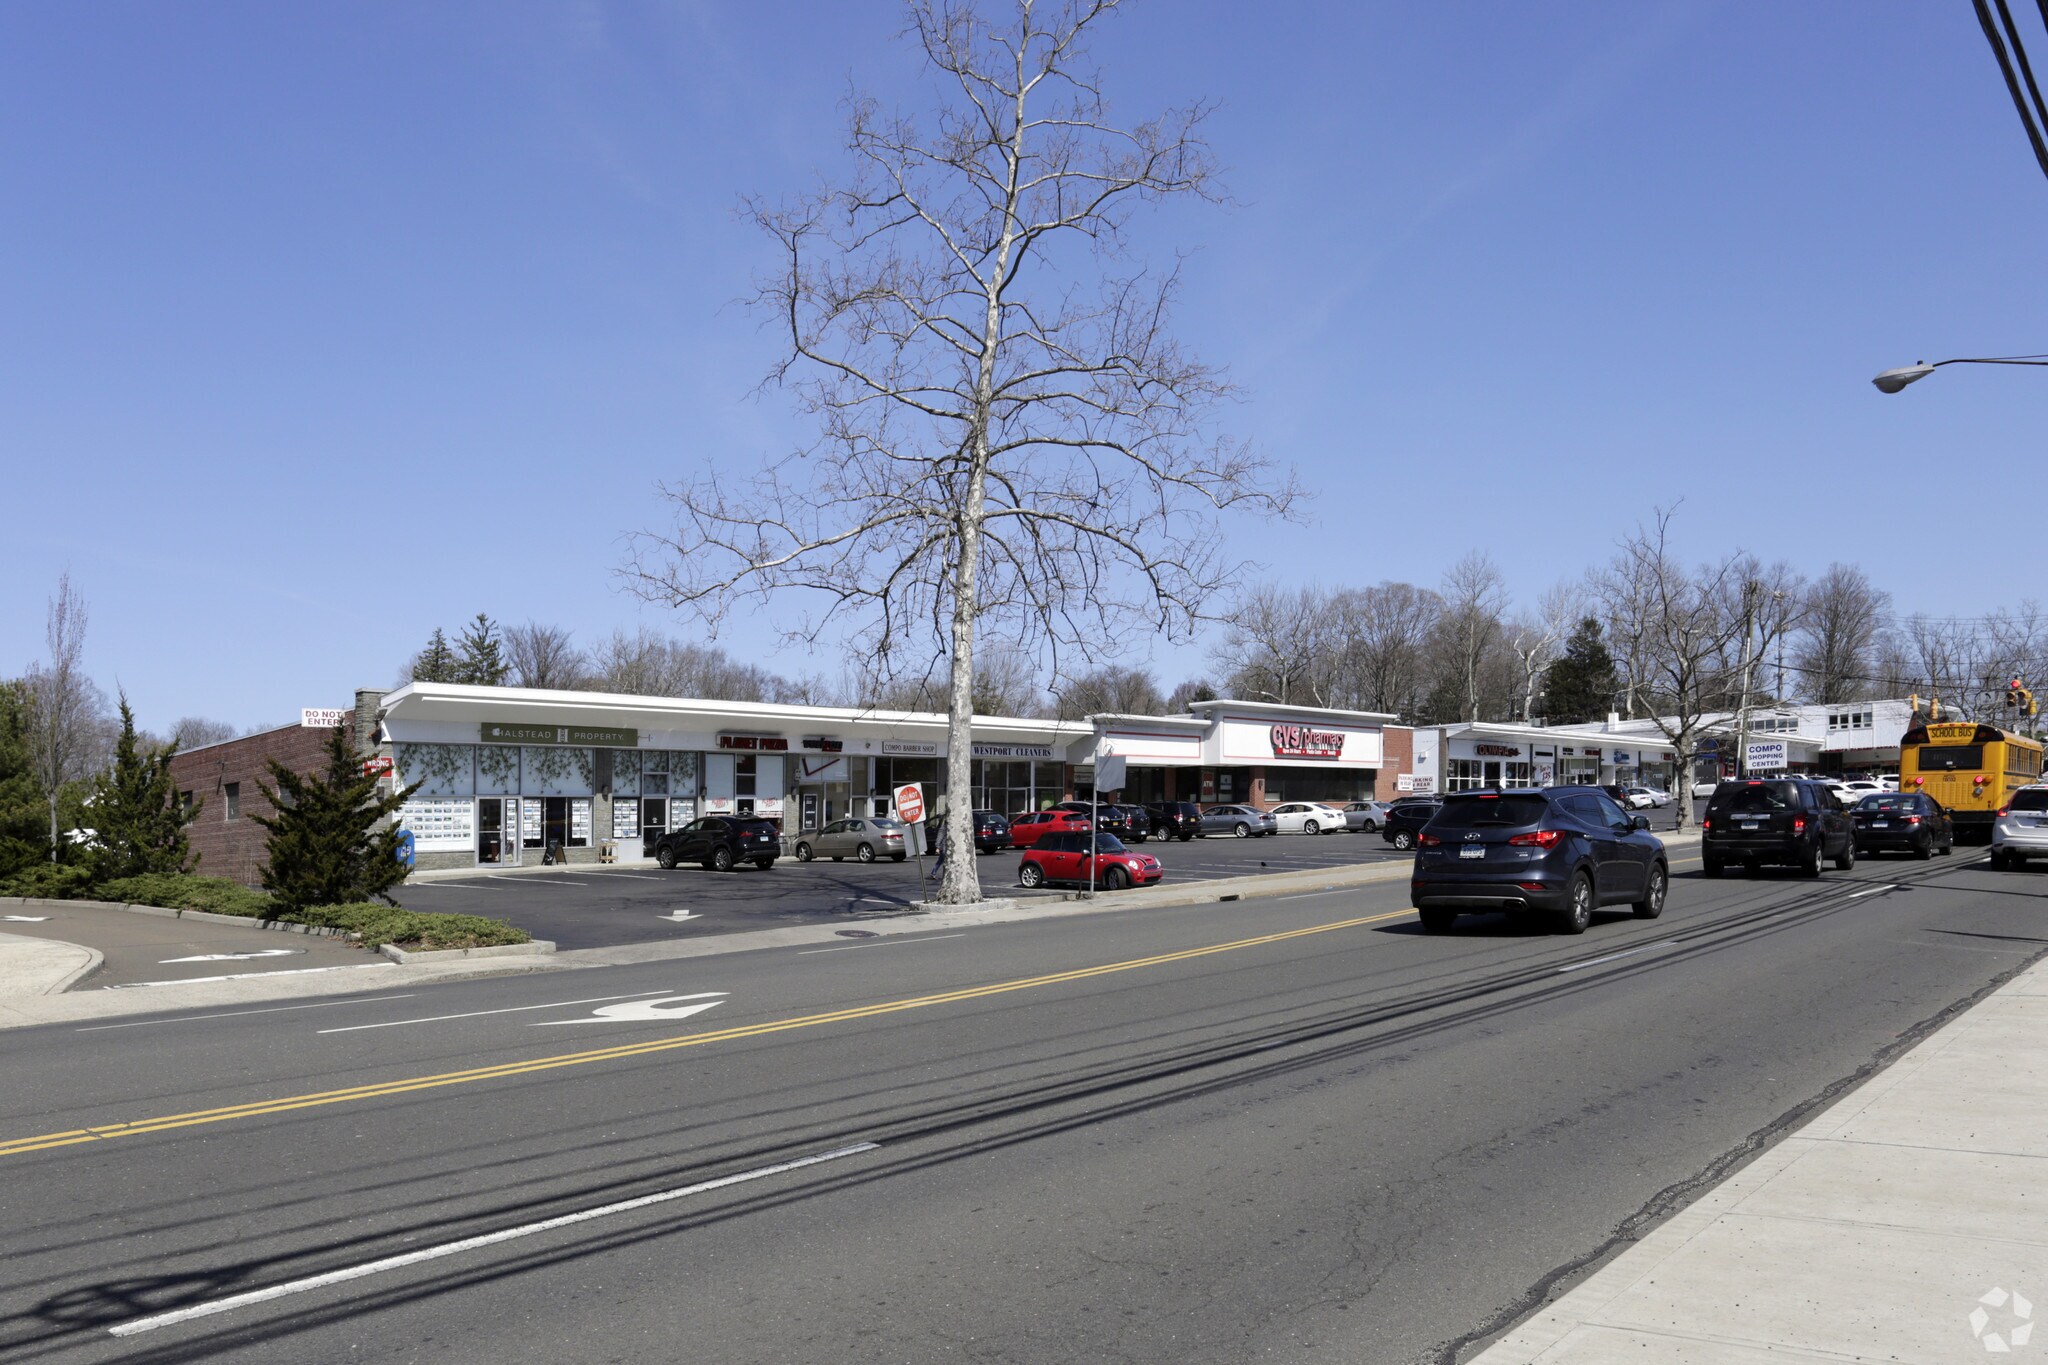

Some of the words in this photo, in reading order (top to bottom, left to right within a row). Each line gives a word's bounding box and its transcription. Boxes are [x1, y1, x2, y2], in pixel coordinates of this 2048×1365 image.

[305, 710, 319, 718] DO
[322, 710, 343, 718] NOT
[308, 718, 340, 726] ENTER
[498, 729, 551, 739] HALSTEAD
[1931, 727, 1956, 738] SCHOOL
[1958, 727, 1972, 737] BUS
[884, 744, 902, 752] COMPO
[903, 744, 921, 753] BARBER
[922, 745, 935, 753] SHOP
[974, 746, 1012, 755] WESTPORT
[1015, 746, 1052, 756] CLEANERS
[1479, 744, 1509, 756] OLYMPIA
[1749, 744, 1782, 753] COMPO
[908, 791, 918, 799] NOT
[904, 808, 919, 818] ENTER
